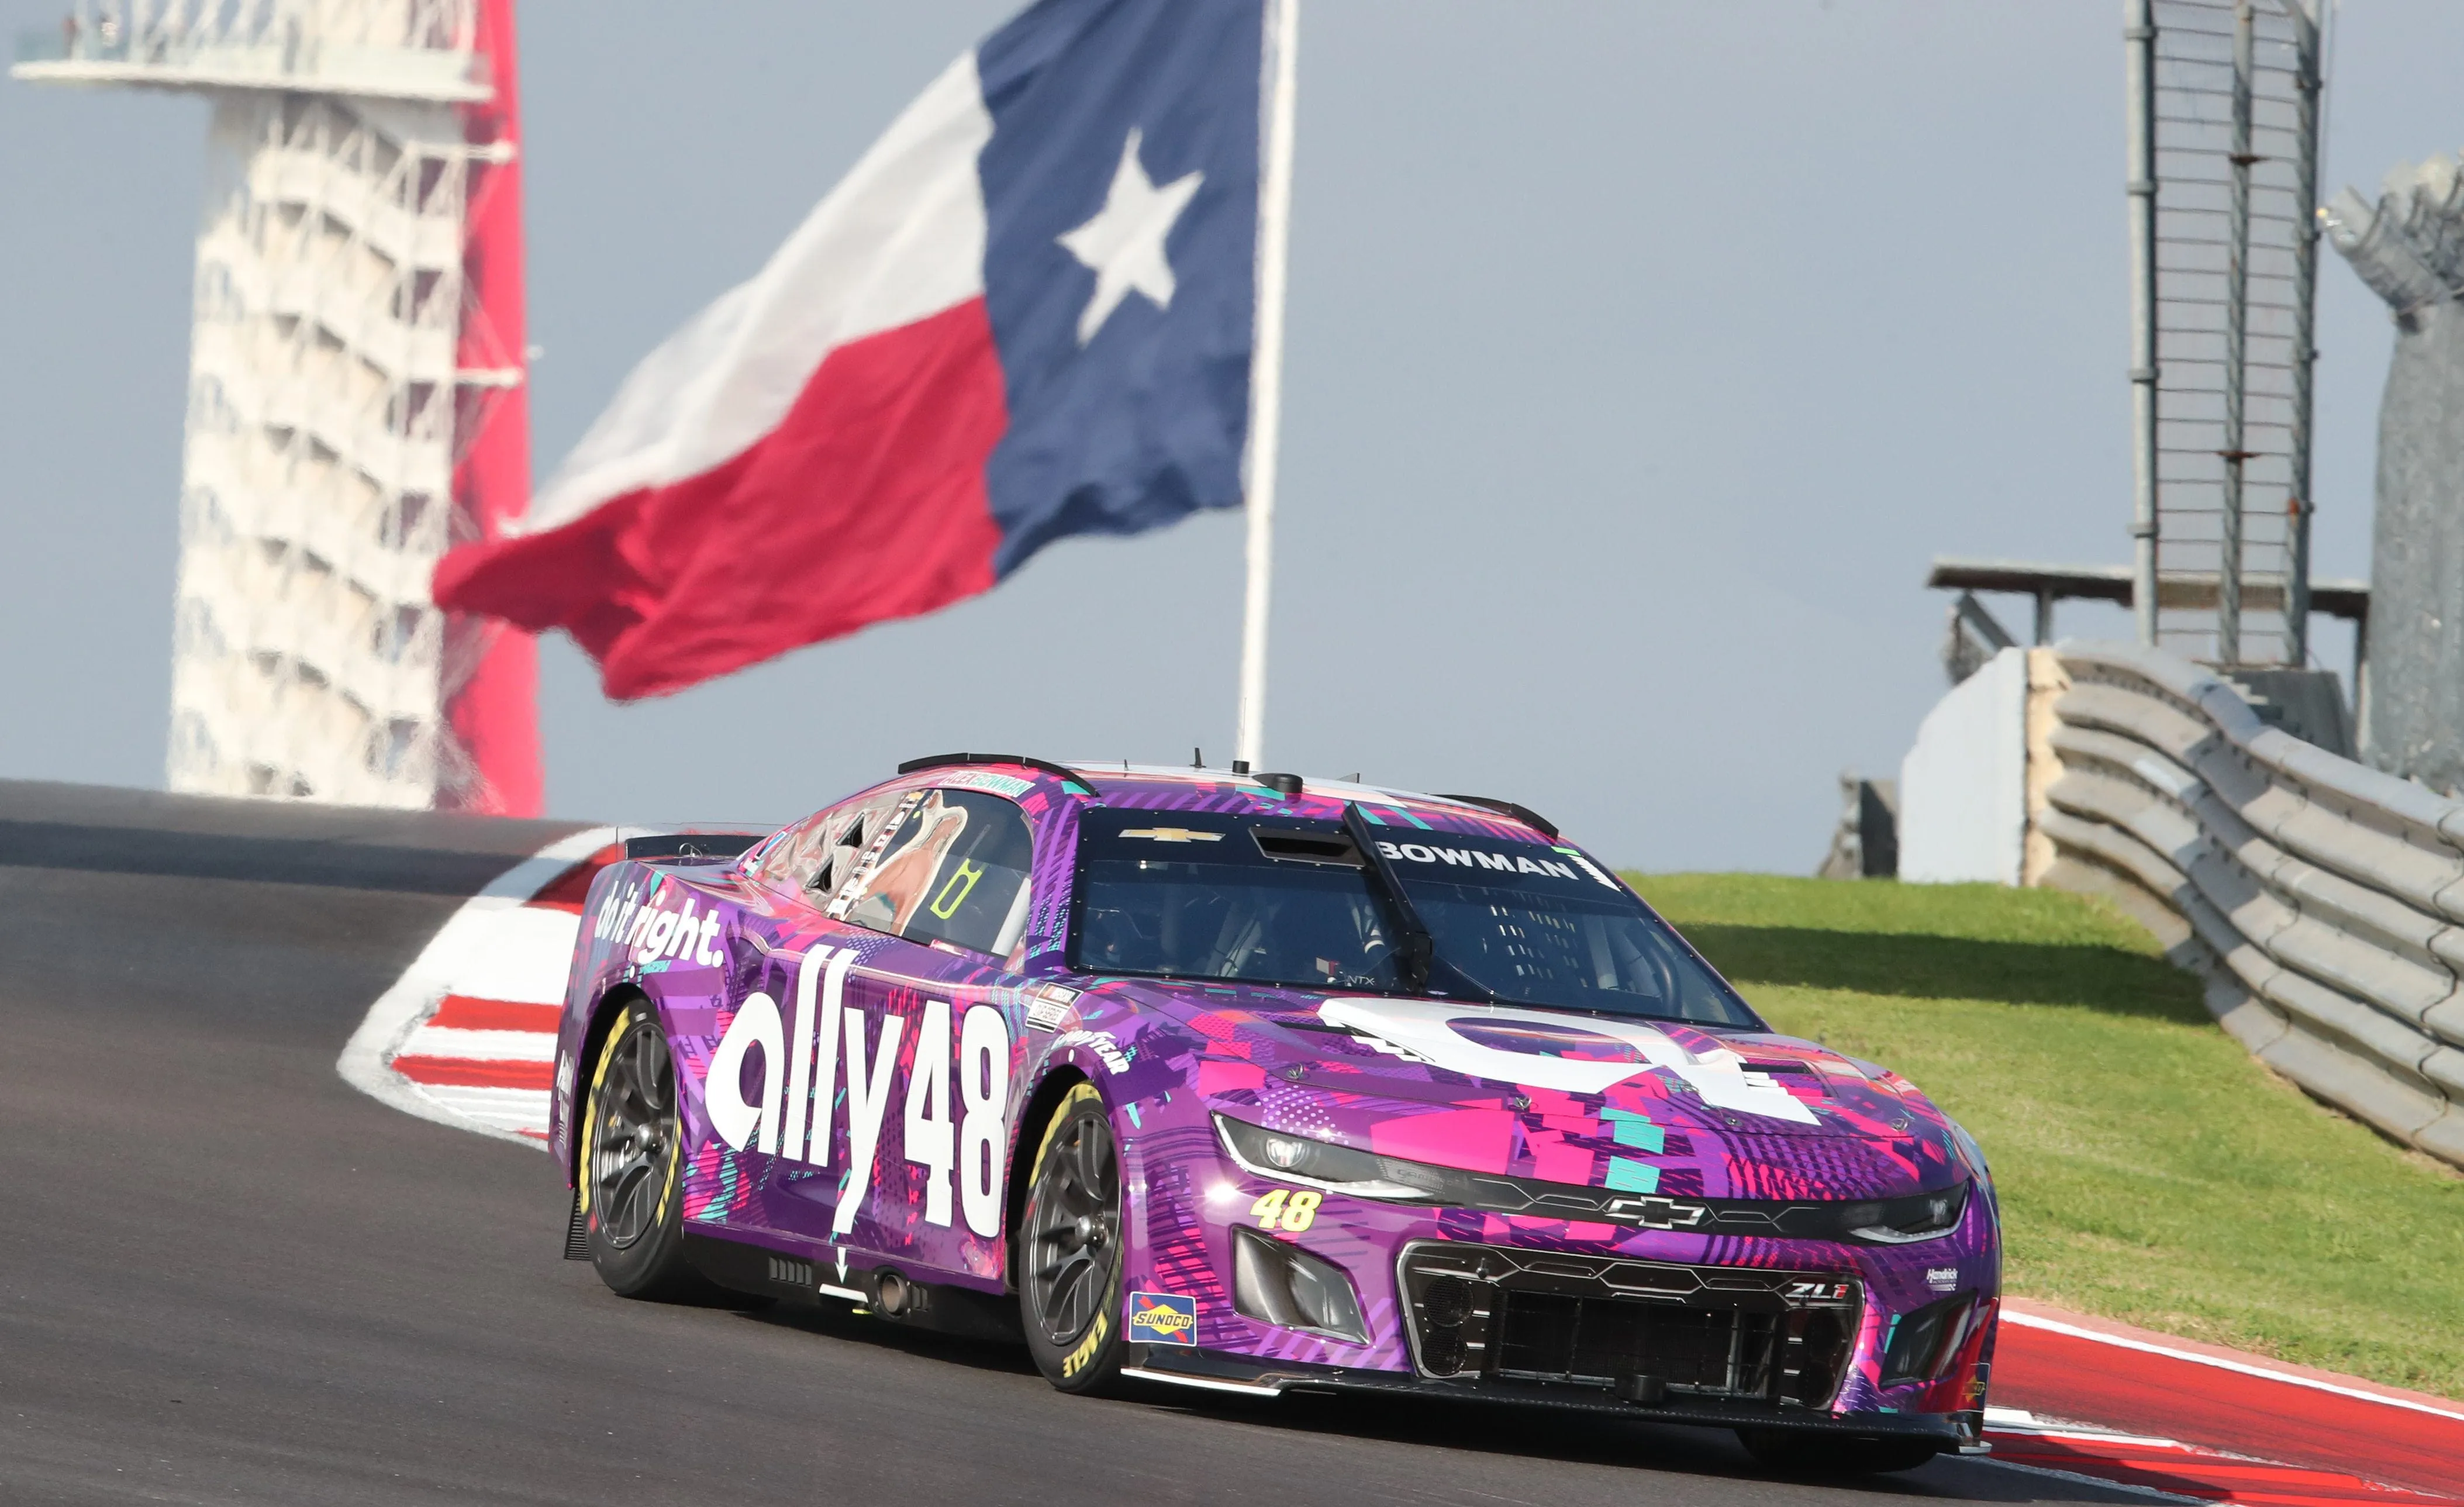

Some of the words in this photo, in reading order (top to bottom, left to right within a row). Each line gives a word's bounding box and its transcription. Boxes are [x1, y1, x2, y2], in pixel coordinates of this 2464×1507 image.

[1375, 840, 1580, 880] BOWMAN
[594, 880, 620, 940] do
[610, 882, 639, 943] it
[624, 889, 724, 968] right.
[705, 943, 905, 1234] ally
[905, 999, 1010, 1238] 48
[1250, 1188, 1324, 1232] 48
[1136, 1313, 1190, 1328] SUNOCO
[1785, 1282, 1849, 1299] ZL1
[1062, 1308, 1109, 1378] EAGLE
